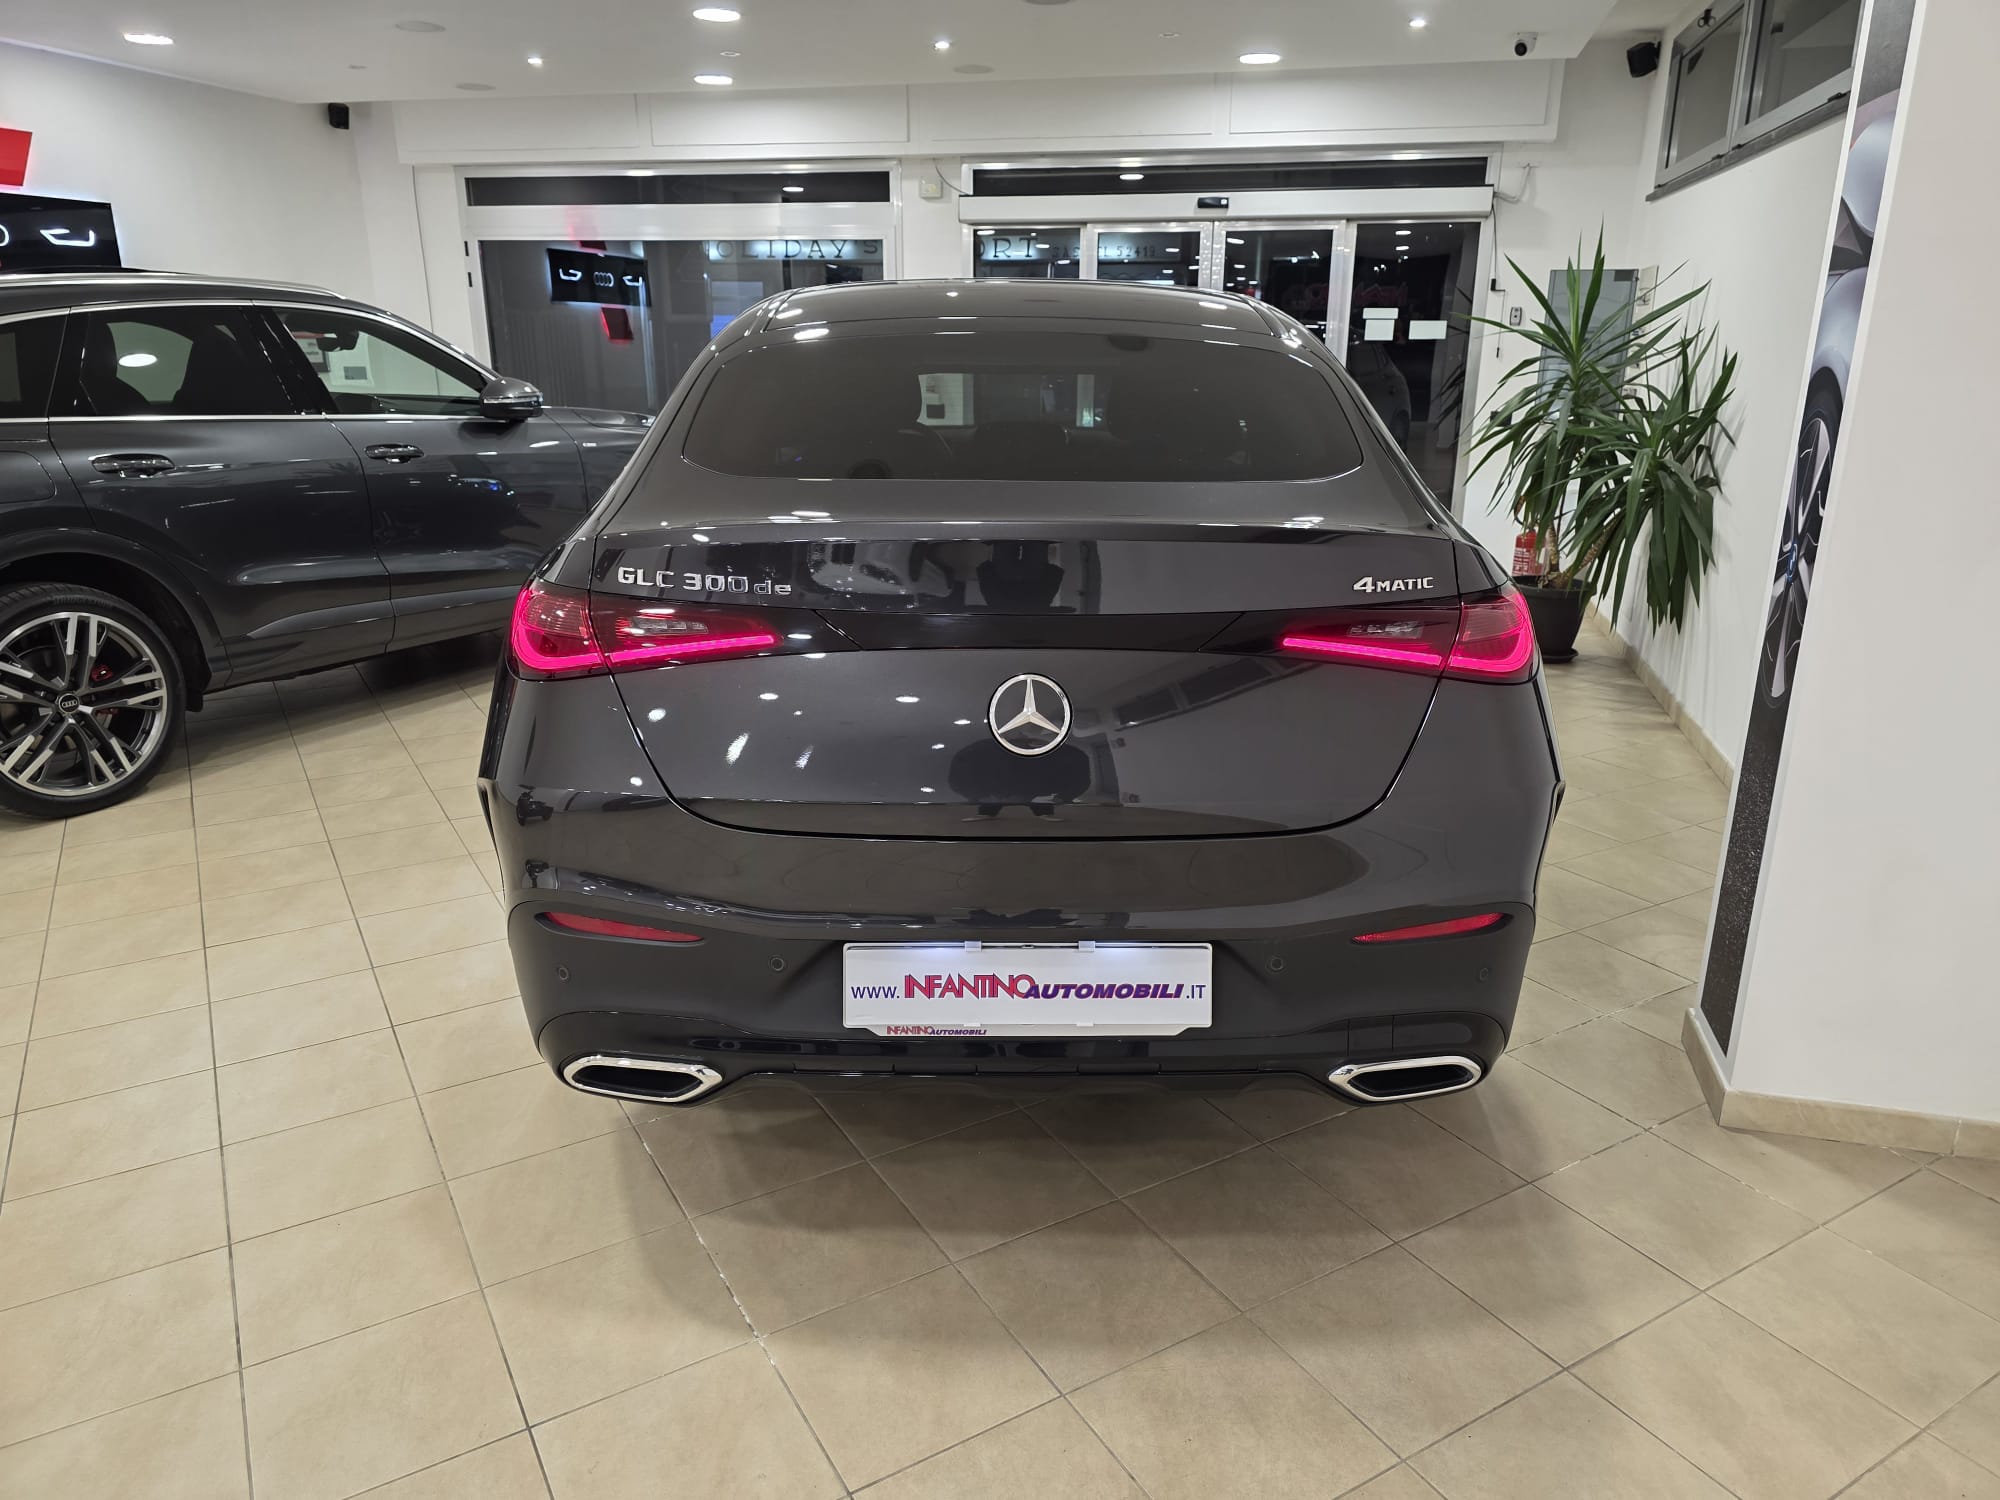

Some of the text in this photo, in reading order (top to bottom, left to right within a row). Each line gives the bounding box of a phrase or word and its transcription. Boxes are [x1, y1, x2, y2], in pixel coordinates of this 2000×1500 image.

[617, 566, 792, 595] GLC 300 de
[1353, 576, 1434, 593] 4MATIC
